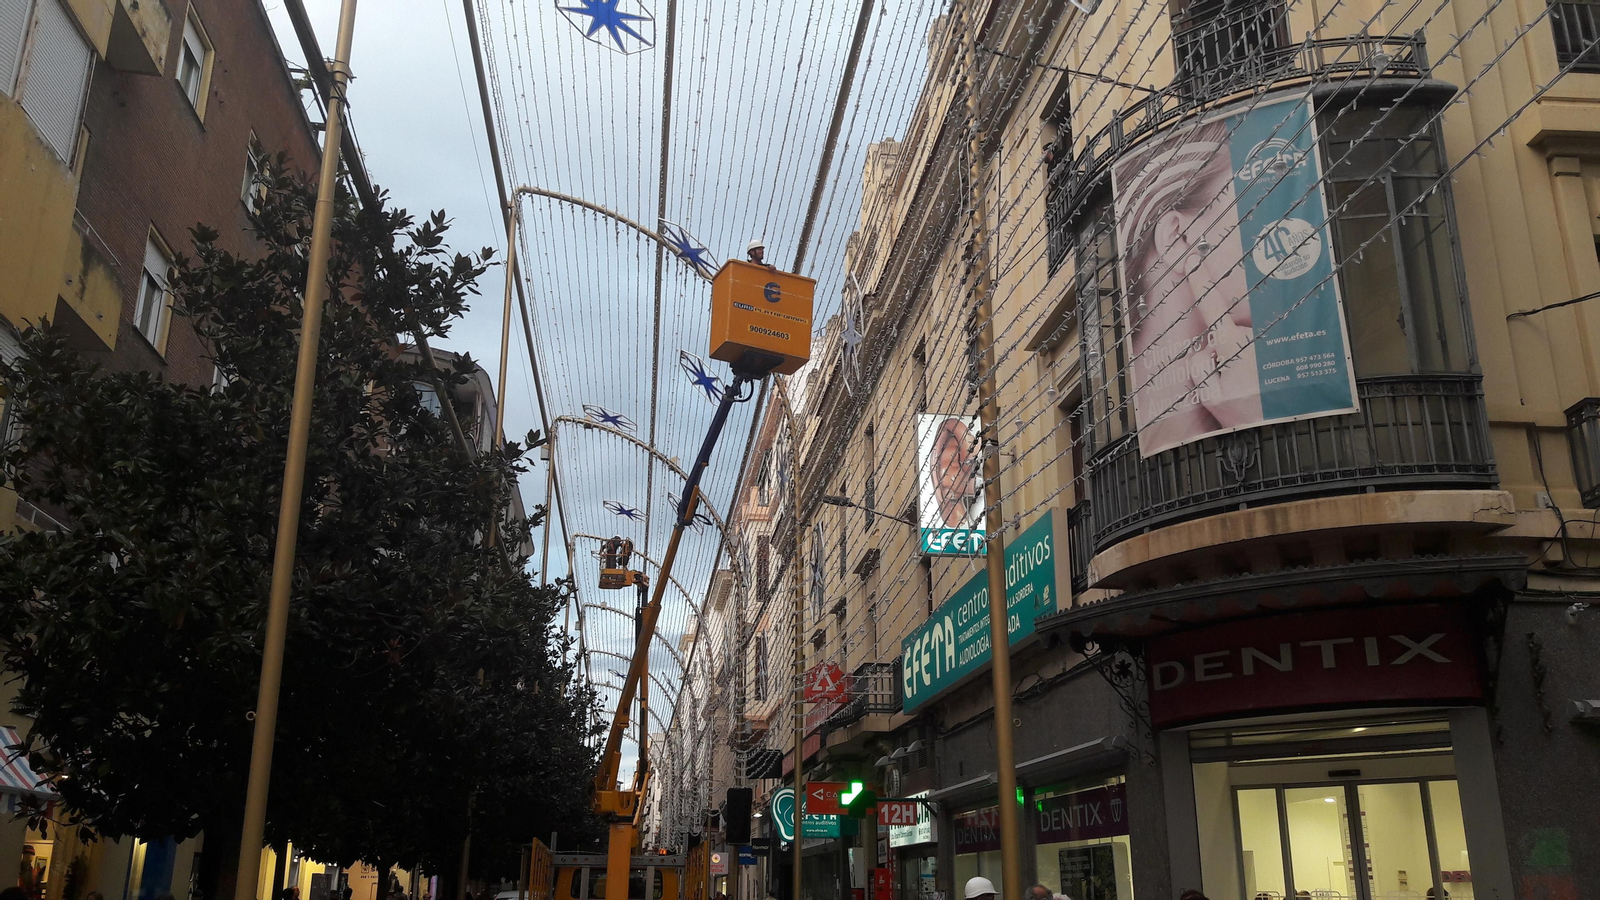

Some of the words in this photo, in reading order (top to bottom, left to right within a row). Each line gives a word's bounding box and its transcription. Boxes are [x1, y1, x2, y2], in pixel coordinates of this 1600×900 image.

[749, 325, 790, 340] 900924603
[1266, 329, 1327, 346] www.efeta.es
[1262, 359, 1295, 370] CÓRDOBA
[1264, 375, 1291, 385] LUCENA
[927, 531, 987, 551] EFET
[1015, 582, 1034, 603] SORDERA
[903, 615, 956, 699] EFETA
[958, 631, 990, 668] AUDIOLOGÍA
[1152, 633, 1453, 691] DENTIX
[881, 804, 914, 824] 12H
[1040, 801, 1103, 832] DENTIX
[957, 825, 997, 845] DENTIX
